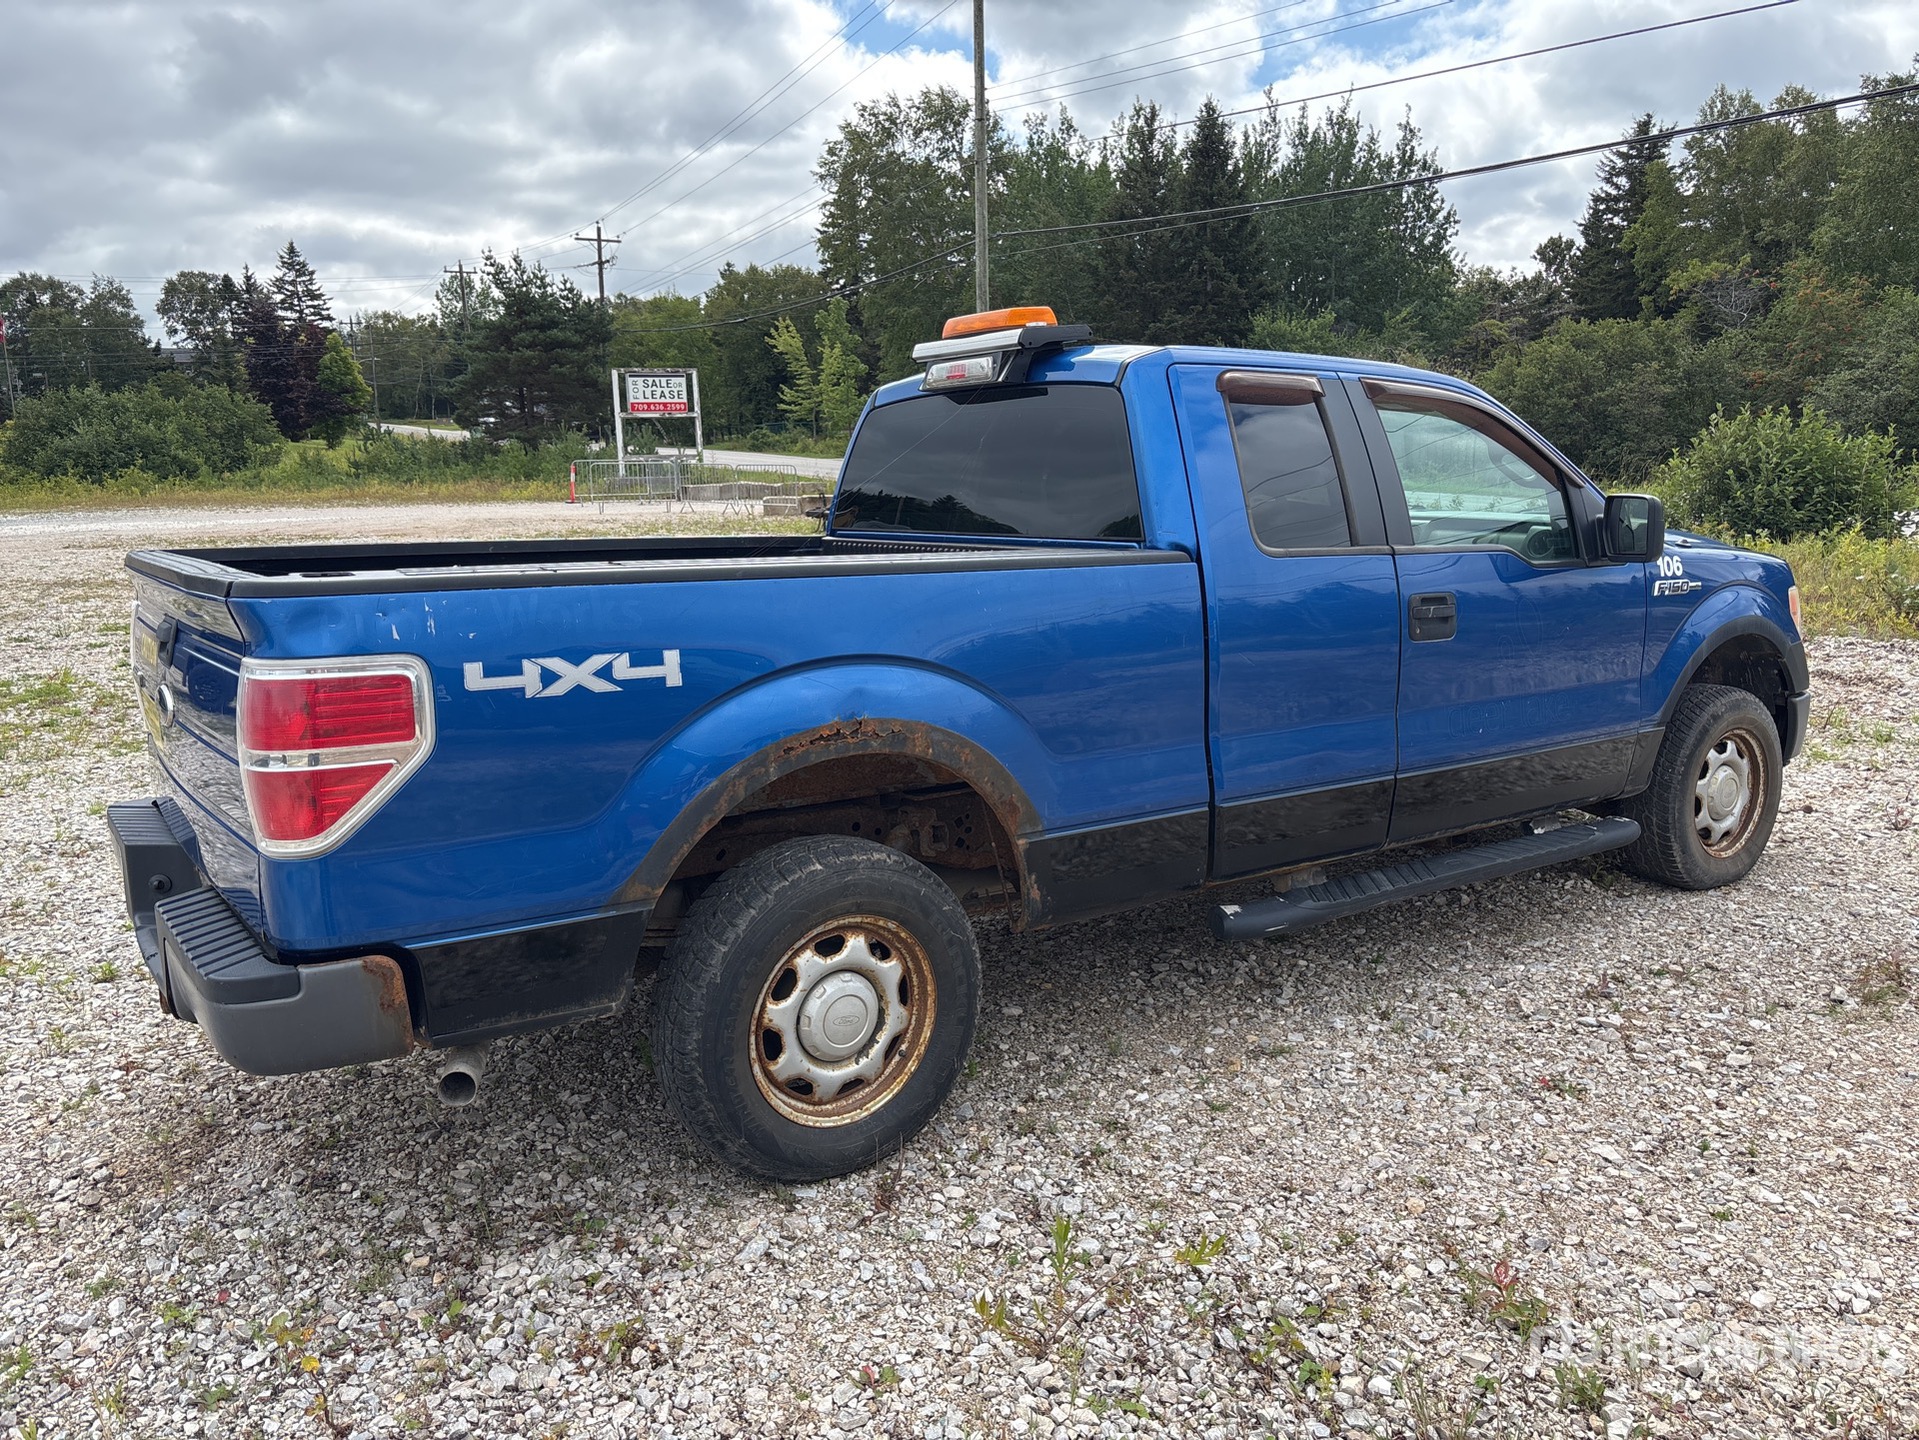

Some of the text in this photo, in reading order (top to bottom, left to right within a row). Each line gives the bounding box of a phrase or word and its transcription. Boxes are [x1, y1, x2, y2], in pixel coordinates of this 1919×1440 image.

[642, 379, 672, 389] SALE
[632, 379, 640, 400] FOR
[642, 390, 684, 400] LEASE
[633, 403, 685, 411] 709.636.2599
[1656, 555, 1683, 577] 106
